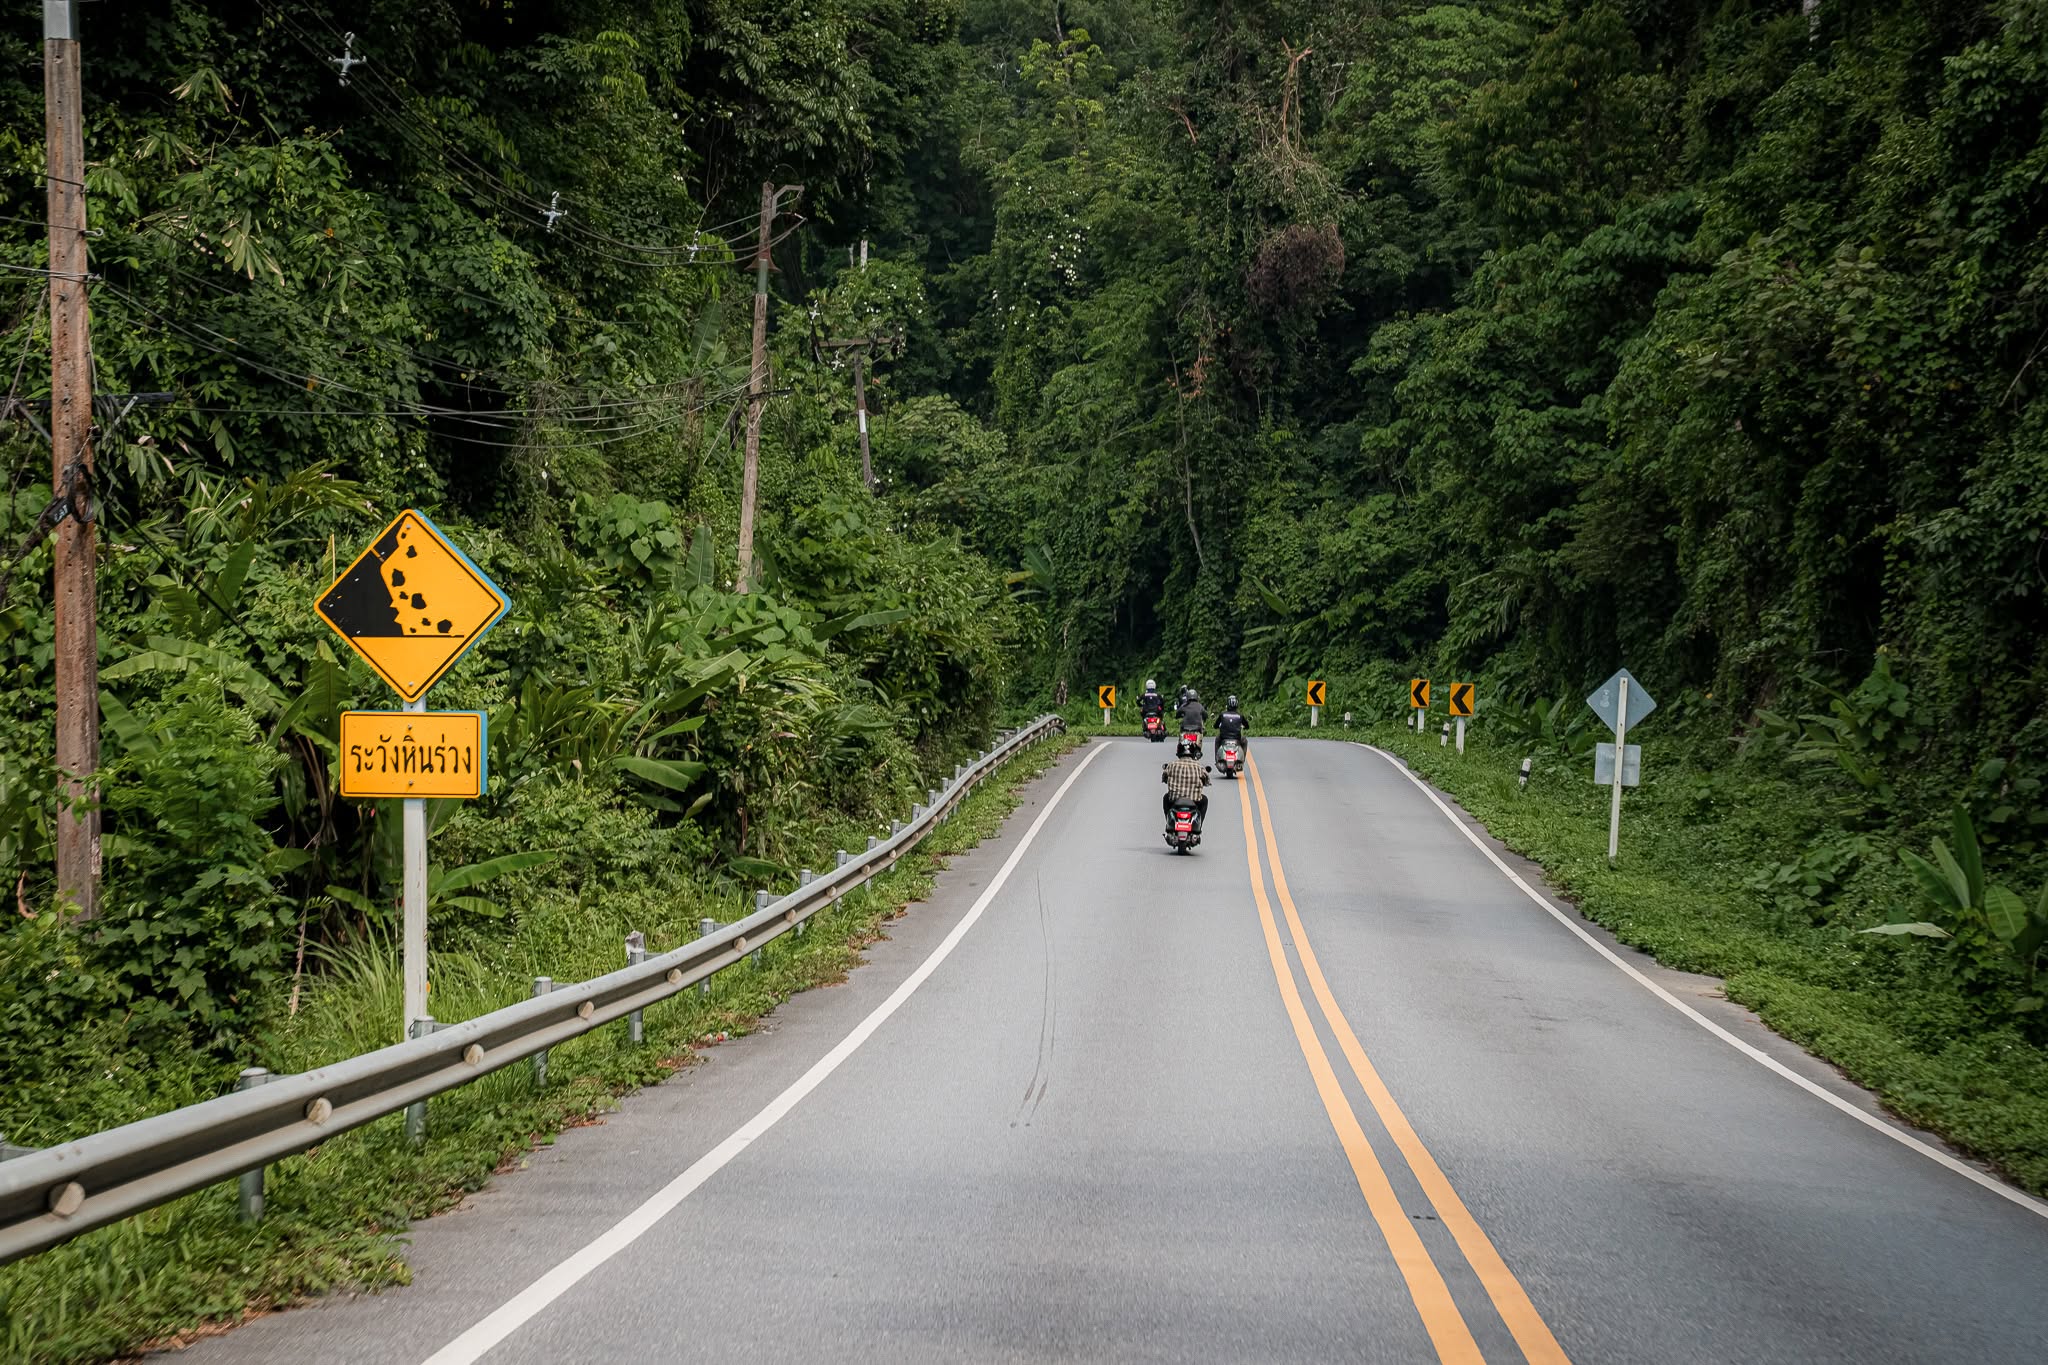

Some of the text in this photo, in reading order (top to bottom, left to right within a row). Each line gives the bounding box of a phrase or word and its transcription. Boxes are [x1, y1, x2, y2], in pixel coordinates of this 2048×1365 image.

[351, 733, 471, 774] ระวังหินร่วง
